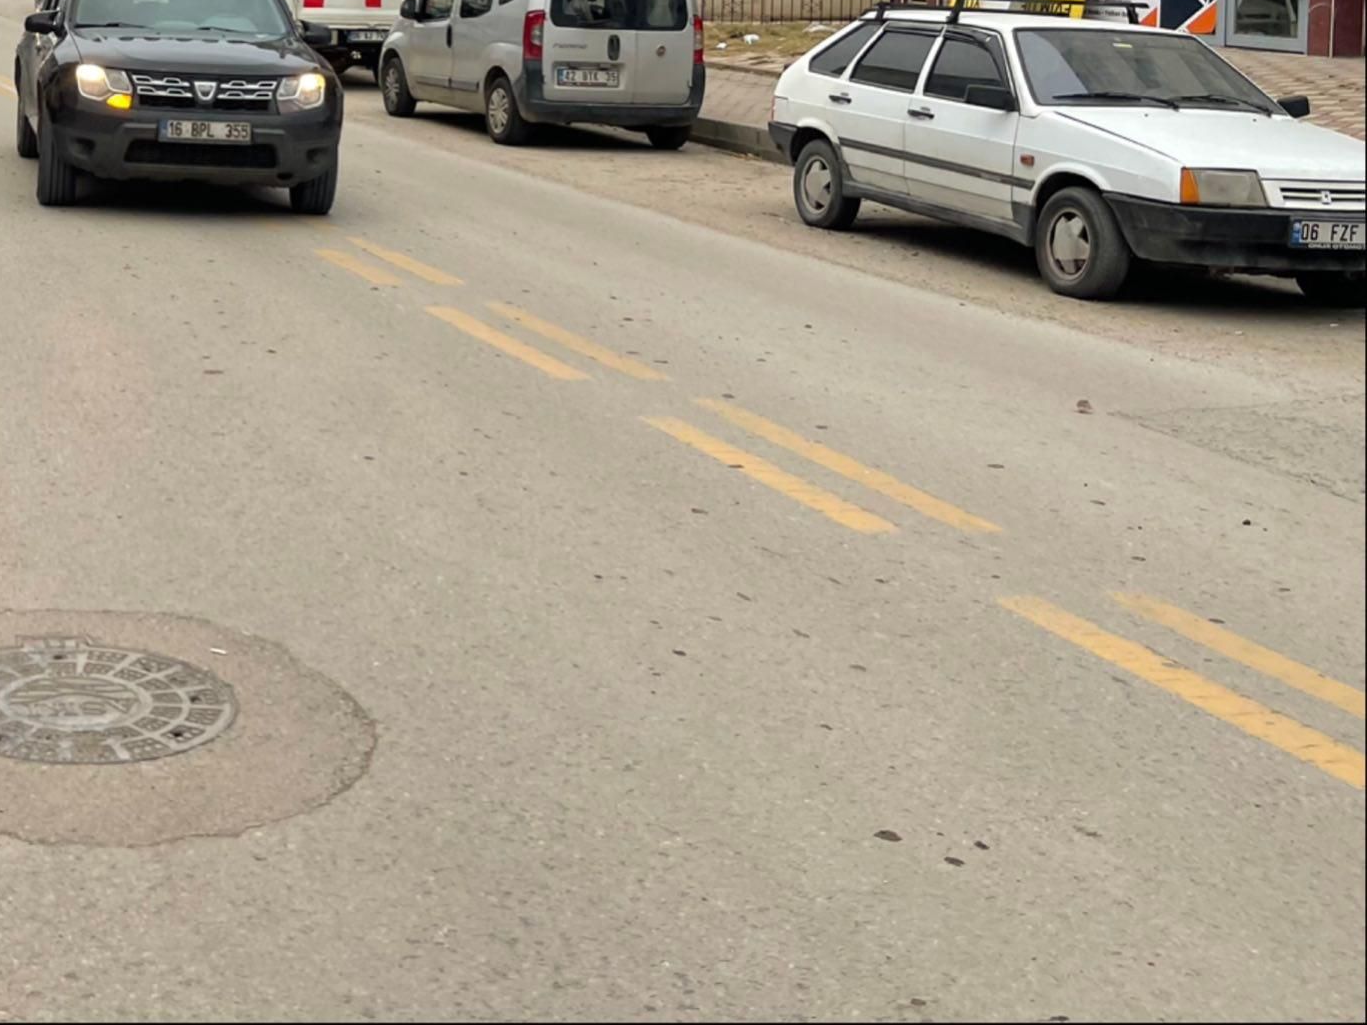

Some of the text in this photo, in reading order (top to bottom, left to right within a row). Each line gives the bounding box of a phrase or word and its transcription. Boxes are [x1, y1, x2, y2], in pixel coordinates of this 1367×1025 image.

[169, 122, 183, 137] 16
[191, 122, 214, 138] BPL
[1301, 223, 1359, 242] 06 FZF
